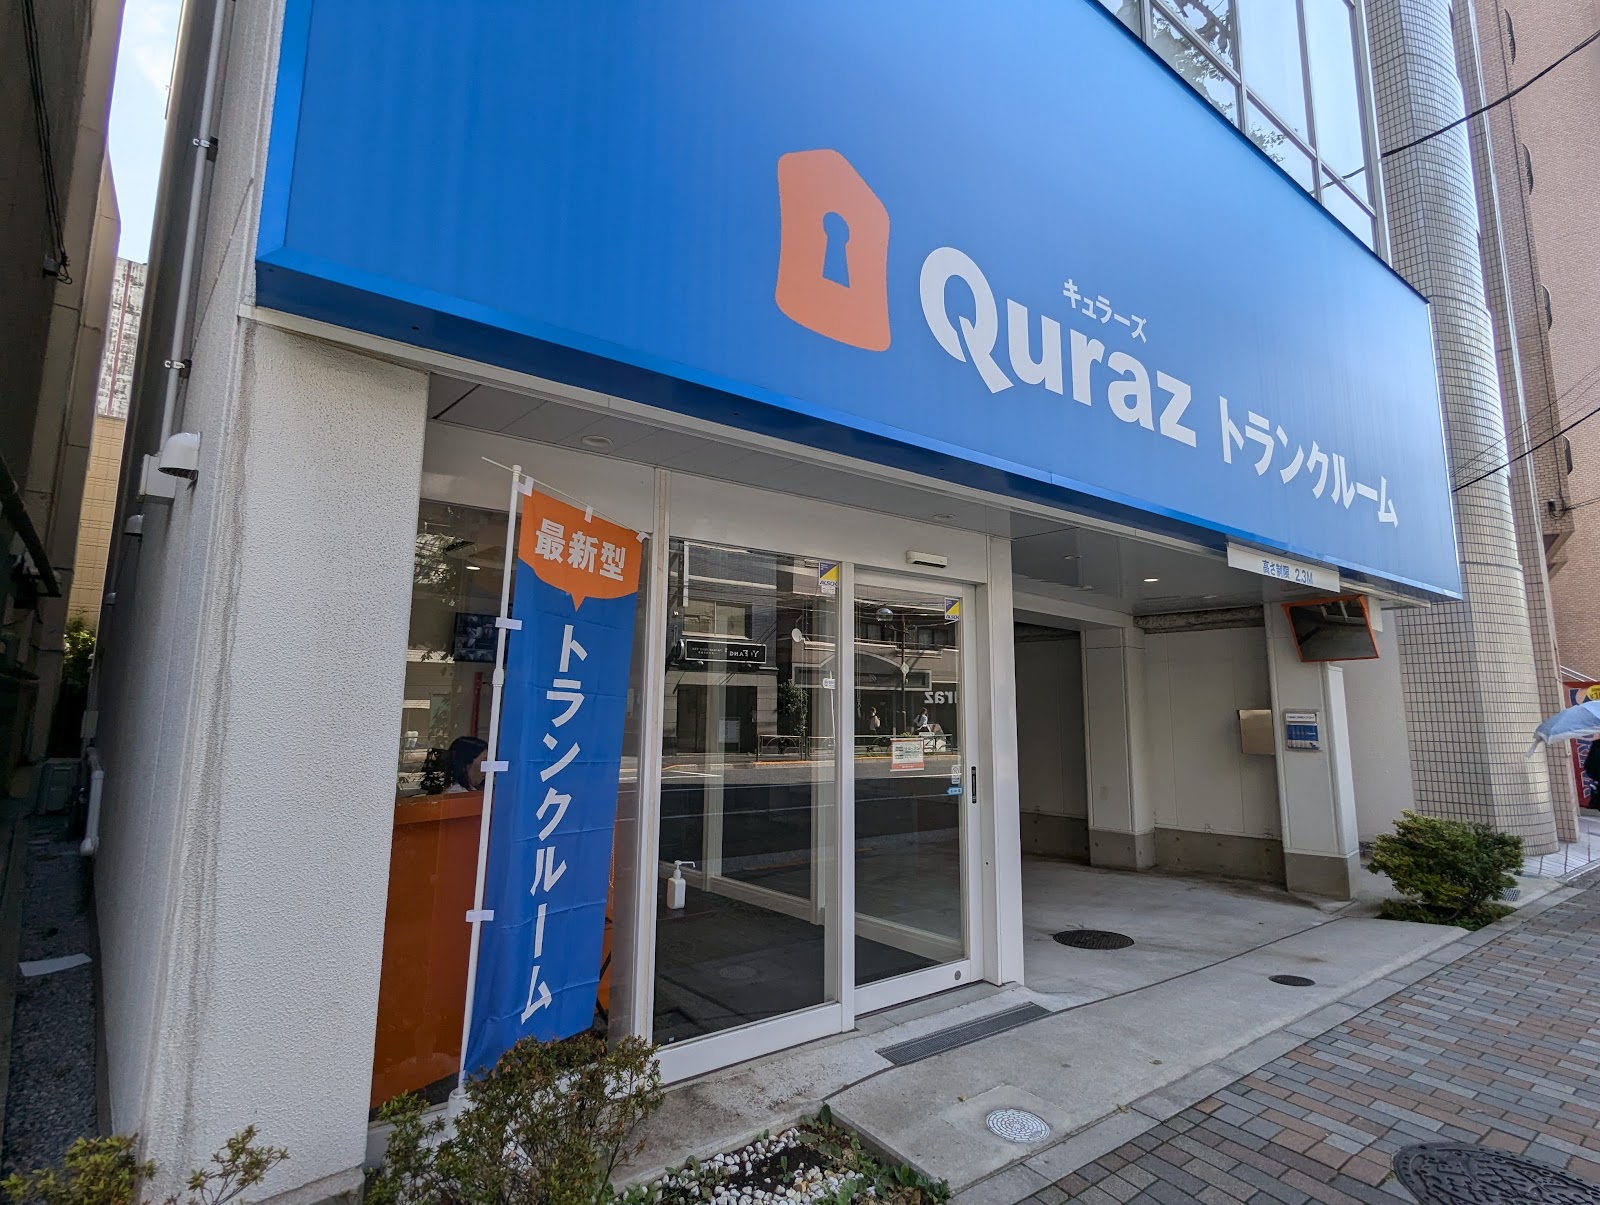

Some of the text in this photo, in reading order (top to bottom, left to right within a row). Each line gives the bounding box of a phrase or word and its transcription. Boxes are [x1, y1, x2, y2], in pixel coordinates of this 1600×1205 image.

[919, 246, 1197, 448] Quraz
[1062, 278, 1148, 343] キュラーズ
[1219, 395, 1400, 529] トランクルーム
[534, 517, 627, 583] 最新型
[1261, 559, 1314, 585] 高さ制限 2.3M
[520, 624, 589, 1026] トランクルーム
